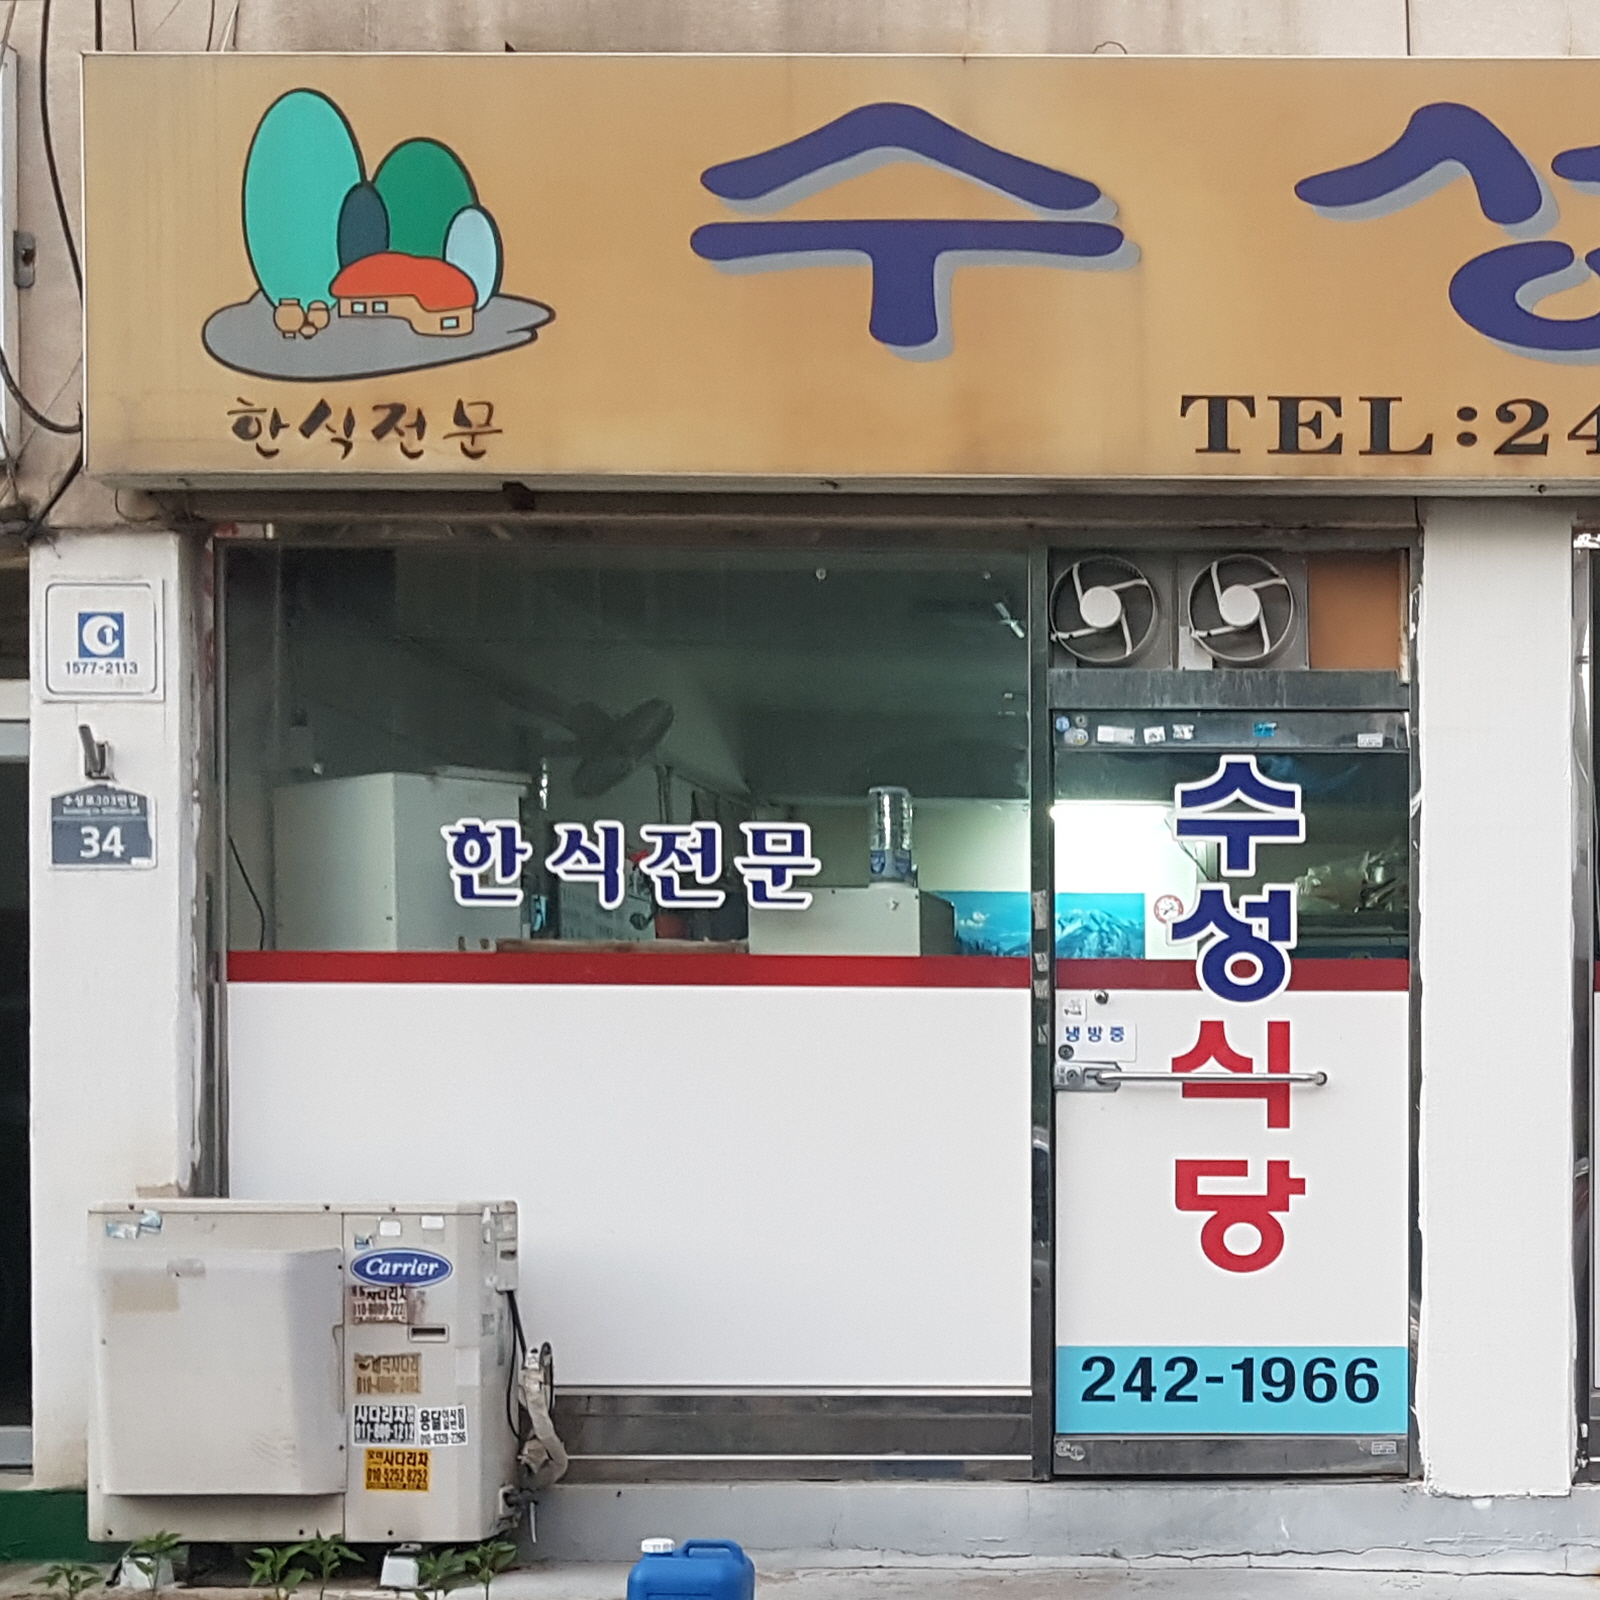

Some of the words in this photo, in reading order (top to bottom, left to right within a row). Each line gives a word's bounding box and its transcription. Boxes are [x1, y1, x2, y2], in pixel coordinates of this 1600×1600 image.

[227, 396, 503, 460] 한식전문
[65, 660, 138, 676] 1577-2113
[80, 825, 125, 858] 34
[441, 817, 822, 911] 한식전문
[1165, 754, 1306, 1272] 수성식당
[365, 1257, 439, 1277] Carrier
[1080, 1356, 1380, 1404] 242-1966
